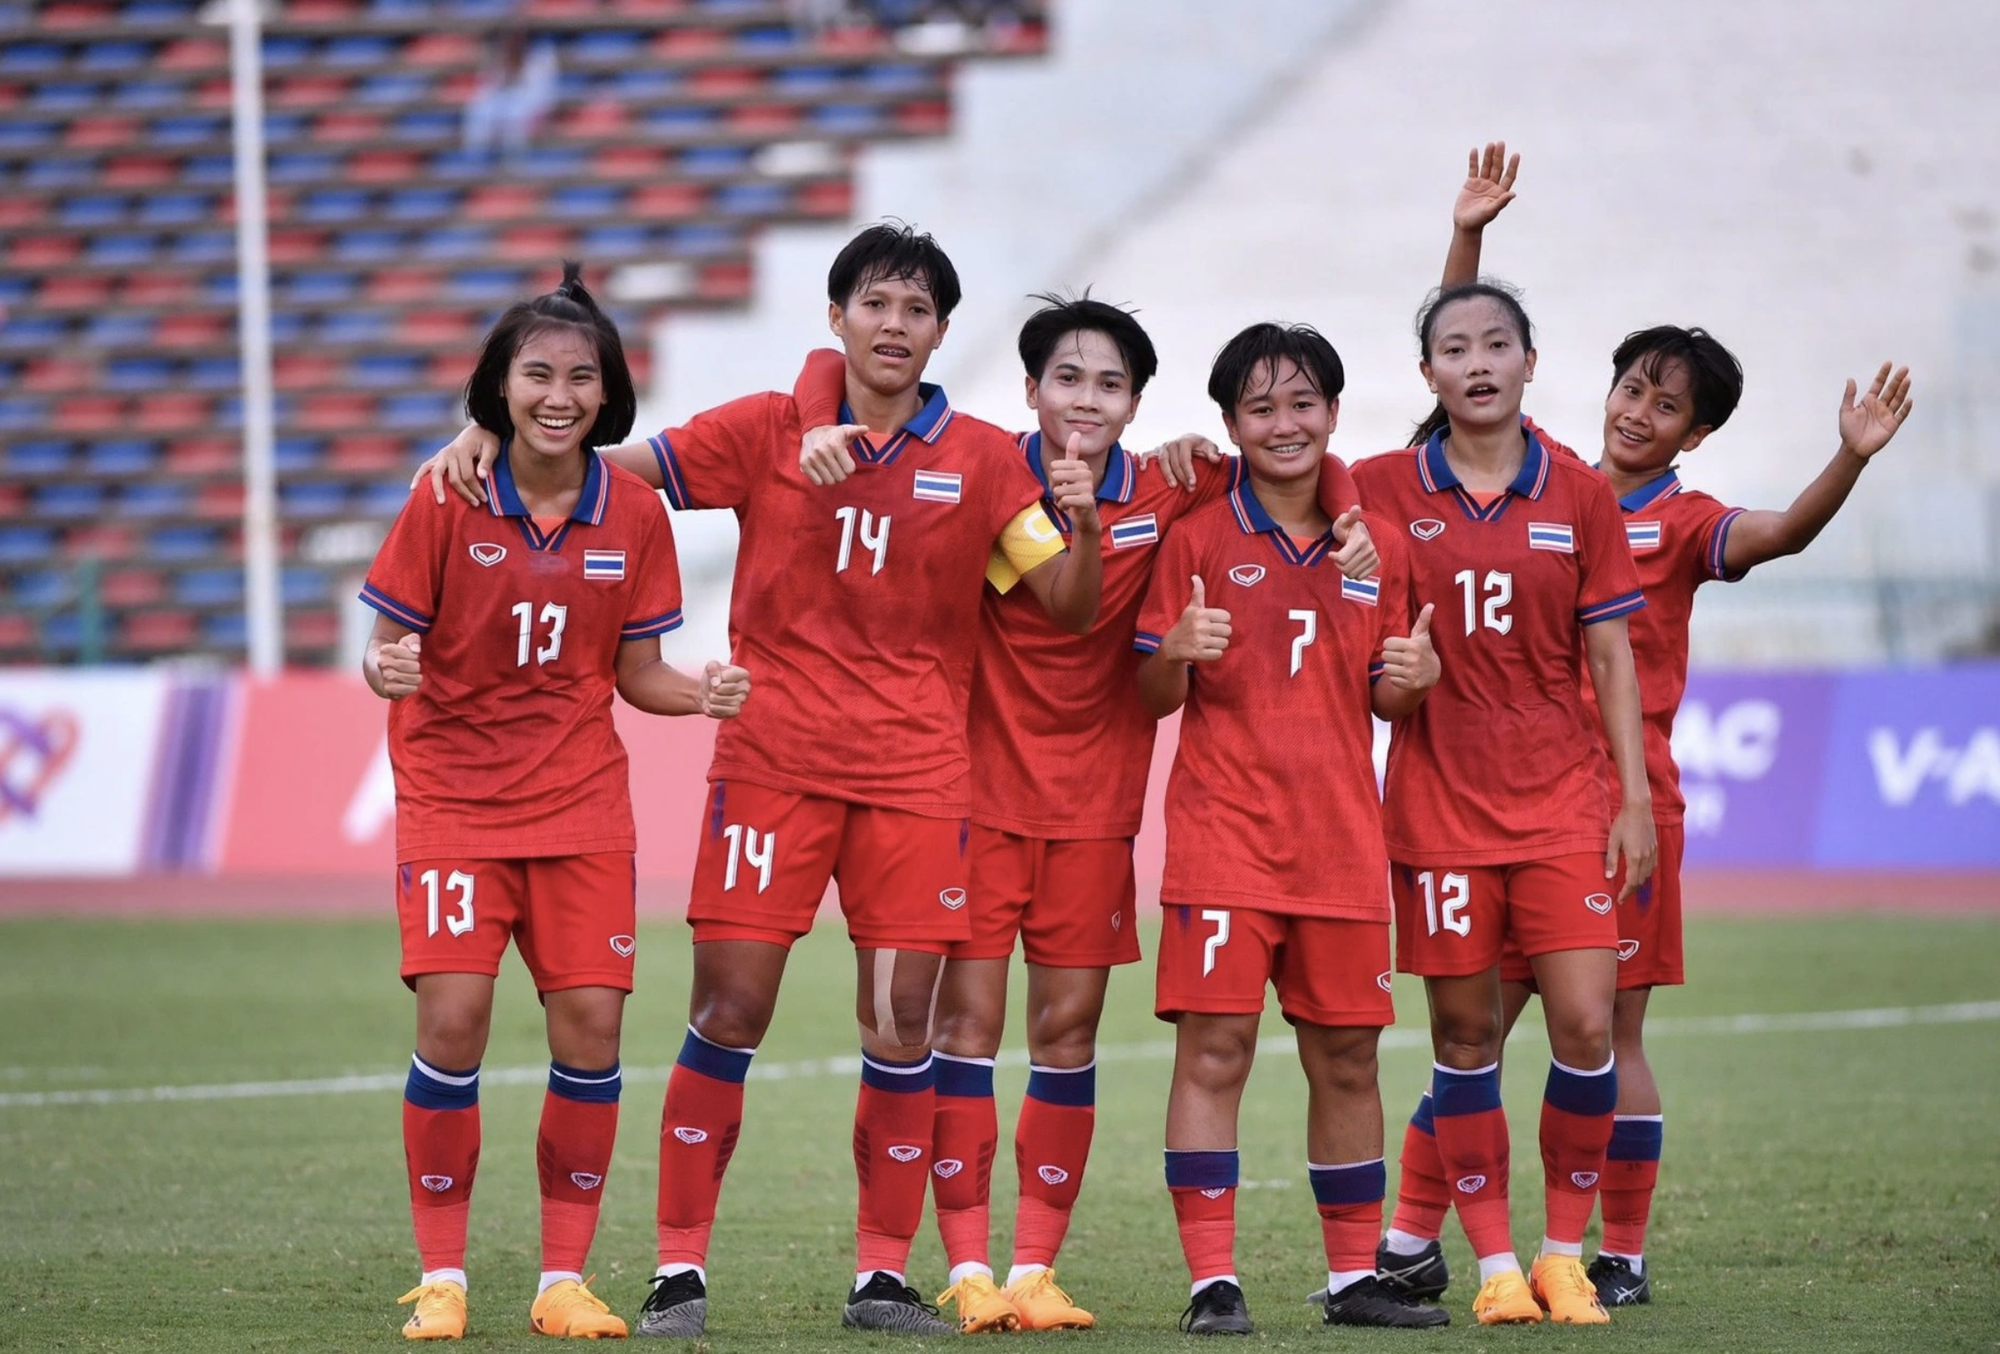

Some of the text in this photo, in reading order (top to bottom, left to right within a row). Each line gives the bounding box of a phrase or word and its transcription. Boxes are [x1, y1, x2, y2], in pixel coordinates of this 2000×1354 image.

[835, 505, 891, 576] 14
[511, 601, 567, 667] 13
[1454, 569, 1512, 637] 12
[1288, 608, 1317, 678] 7
[723, 823, 776, 895] 14
[420, 868, 475, 938] 13
[1417, 871, 1471, 938] 12
[1202, 909, 1231, 978] 7
